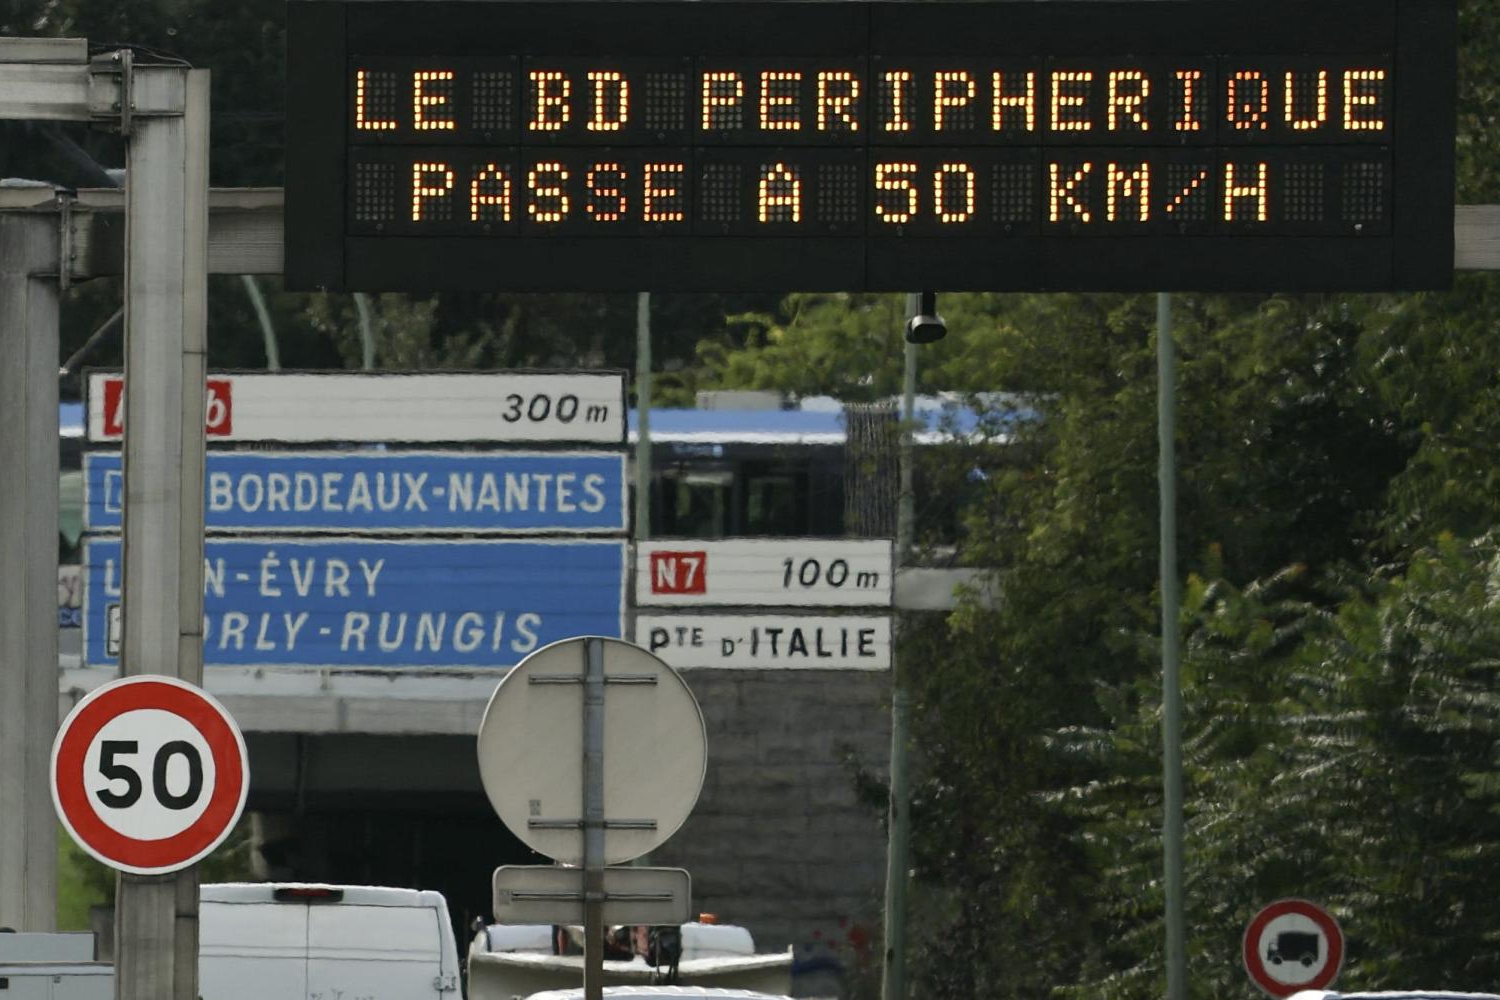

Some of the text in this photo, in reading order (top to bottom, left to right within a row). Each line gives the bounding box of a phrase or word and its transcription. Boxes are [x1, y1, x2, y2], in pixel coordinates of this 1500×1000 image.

[356, 70, 1385, 131] LE BD PERIPHERIQUE
[412, 163, 1267, 222] PASSE A 50 KM/H
[501, 392, 609, 424] 300 m
[209, 471, 607, 513] BORDEAUX-NANTES
[656, 557, 700, 588] N7
[782, 557, 879, 588] 100 m
[96, 740, 203, 810] 50
